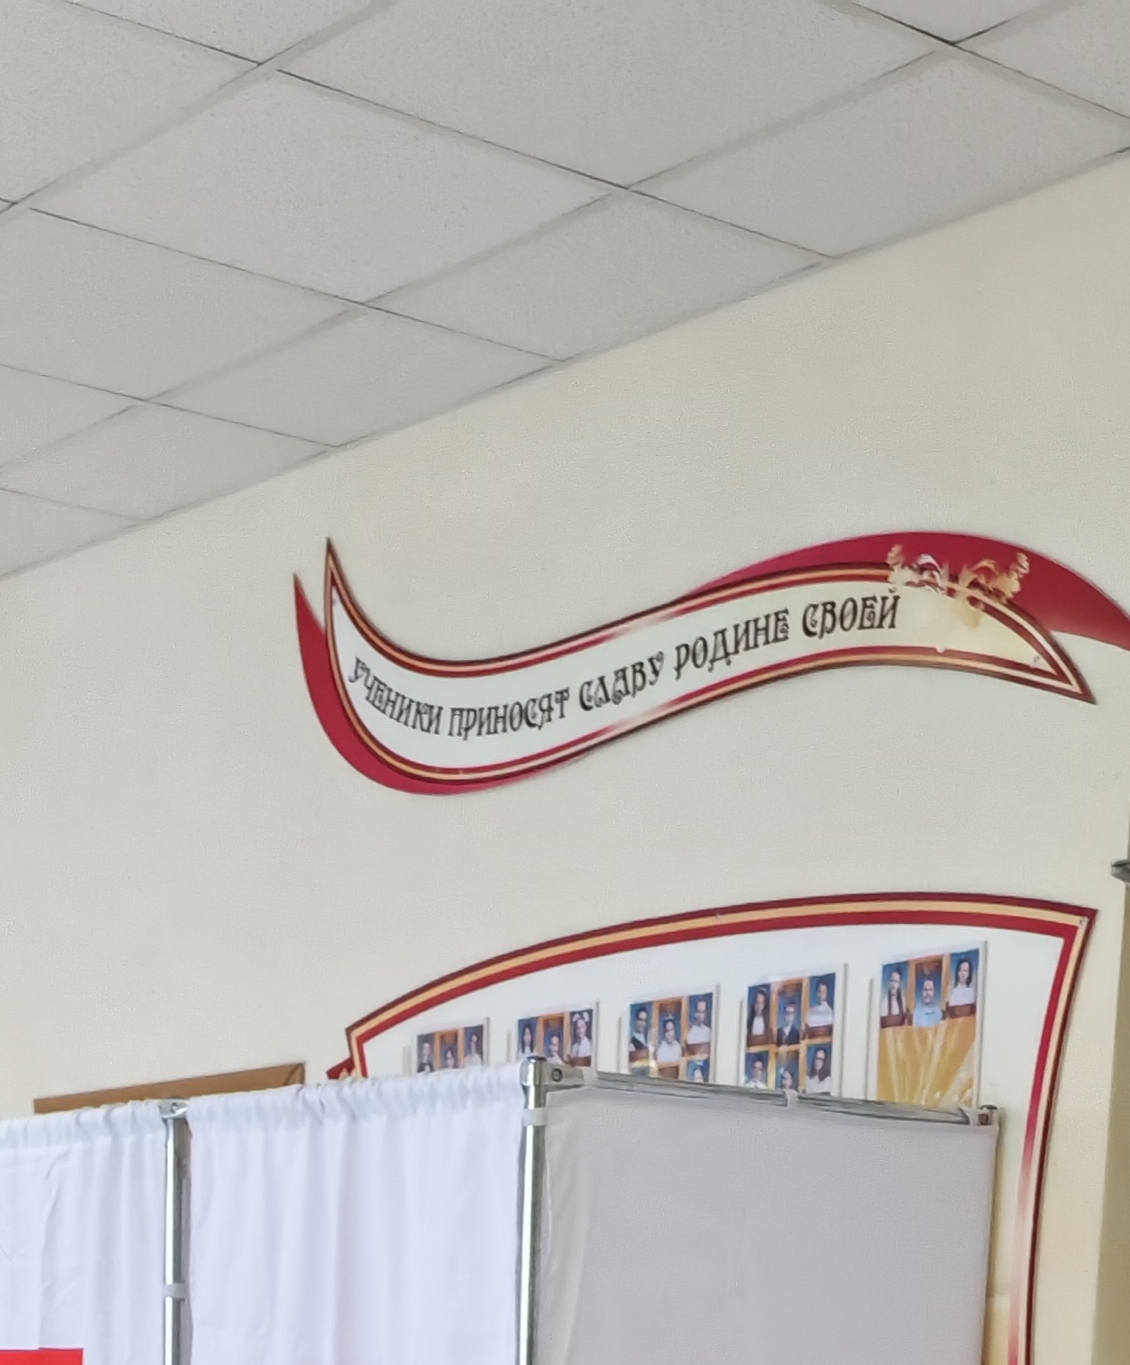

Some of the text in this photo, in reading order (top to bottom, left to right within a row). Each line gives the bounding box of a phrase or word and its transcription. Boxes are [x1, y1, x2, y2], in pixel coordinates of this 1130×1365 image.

[348, 592, 902, 741] УЧЕНИКИ ПРИНОСЯТ СЛАВУ РОДИНЕ СВОЕЙ
